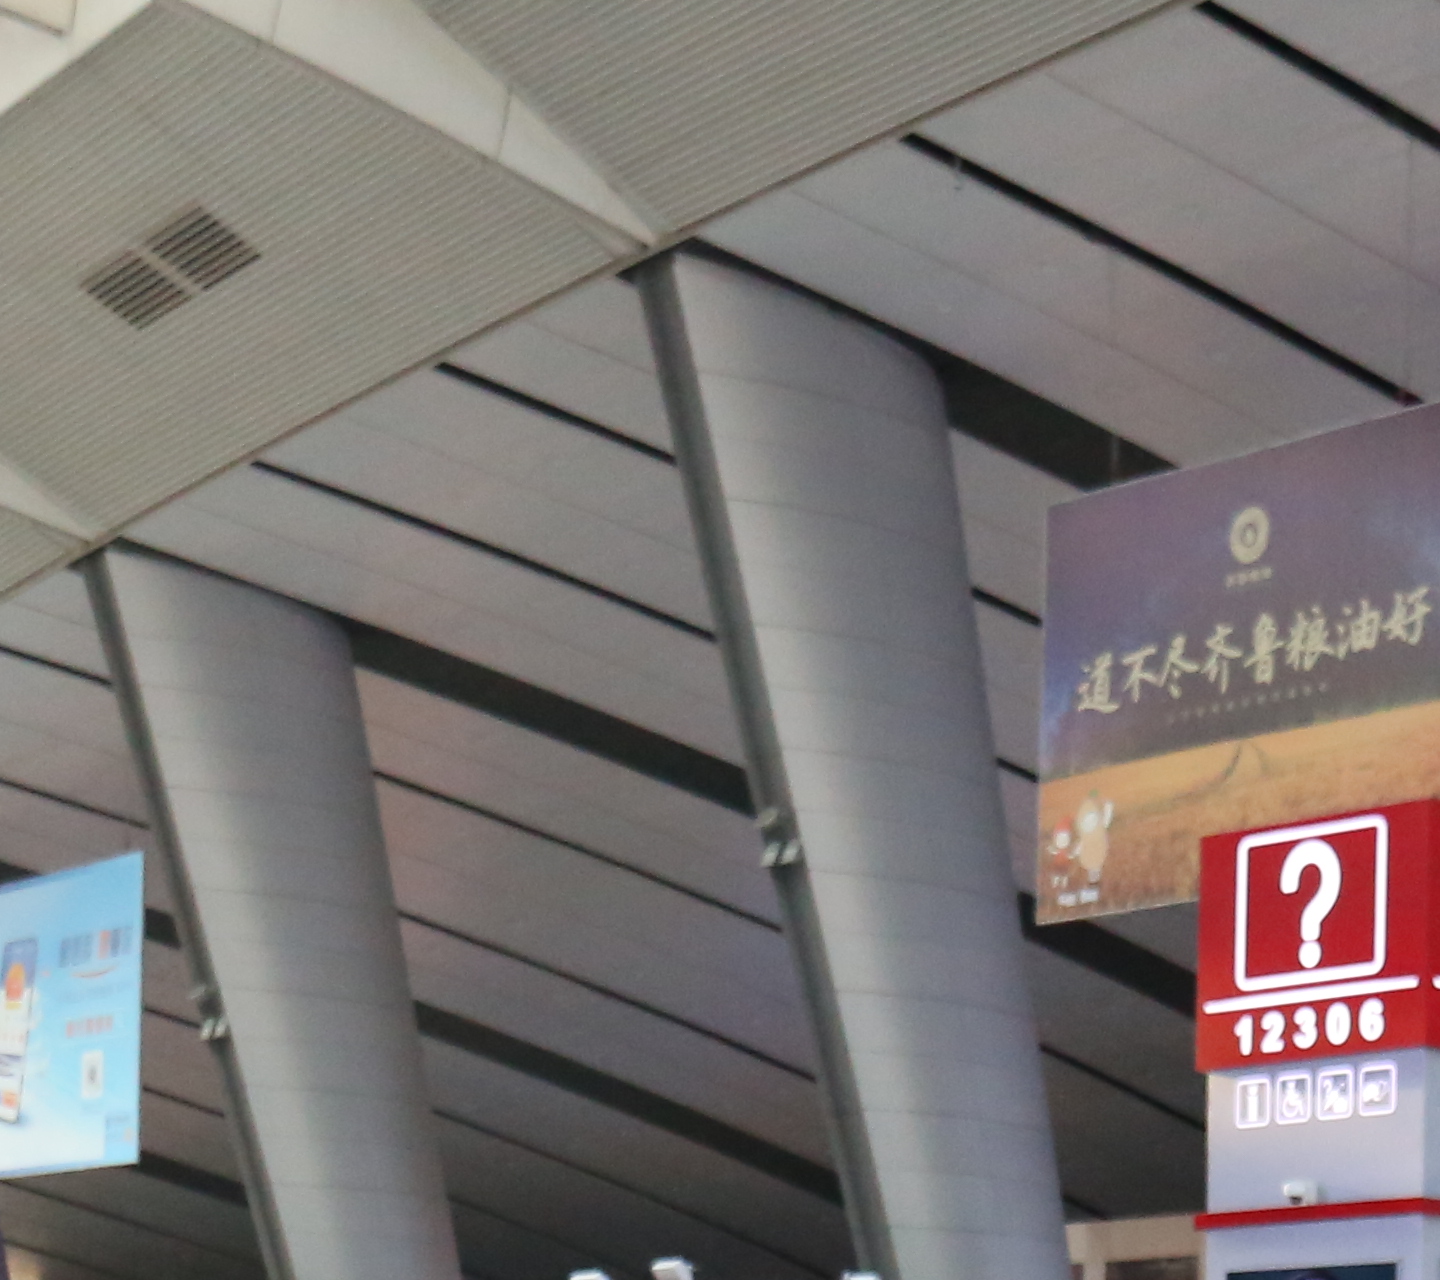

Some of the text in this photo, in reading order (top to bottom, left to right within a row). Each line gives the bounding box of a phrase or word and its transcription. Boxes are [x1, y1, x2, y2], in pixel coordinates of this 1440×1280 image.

[1077, 586, 1433, 714] 道不尽齐鲁粮油好
[1231, 997, 1383, 1055] 12306
